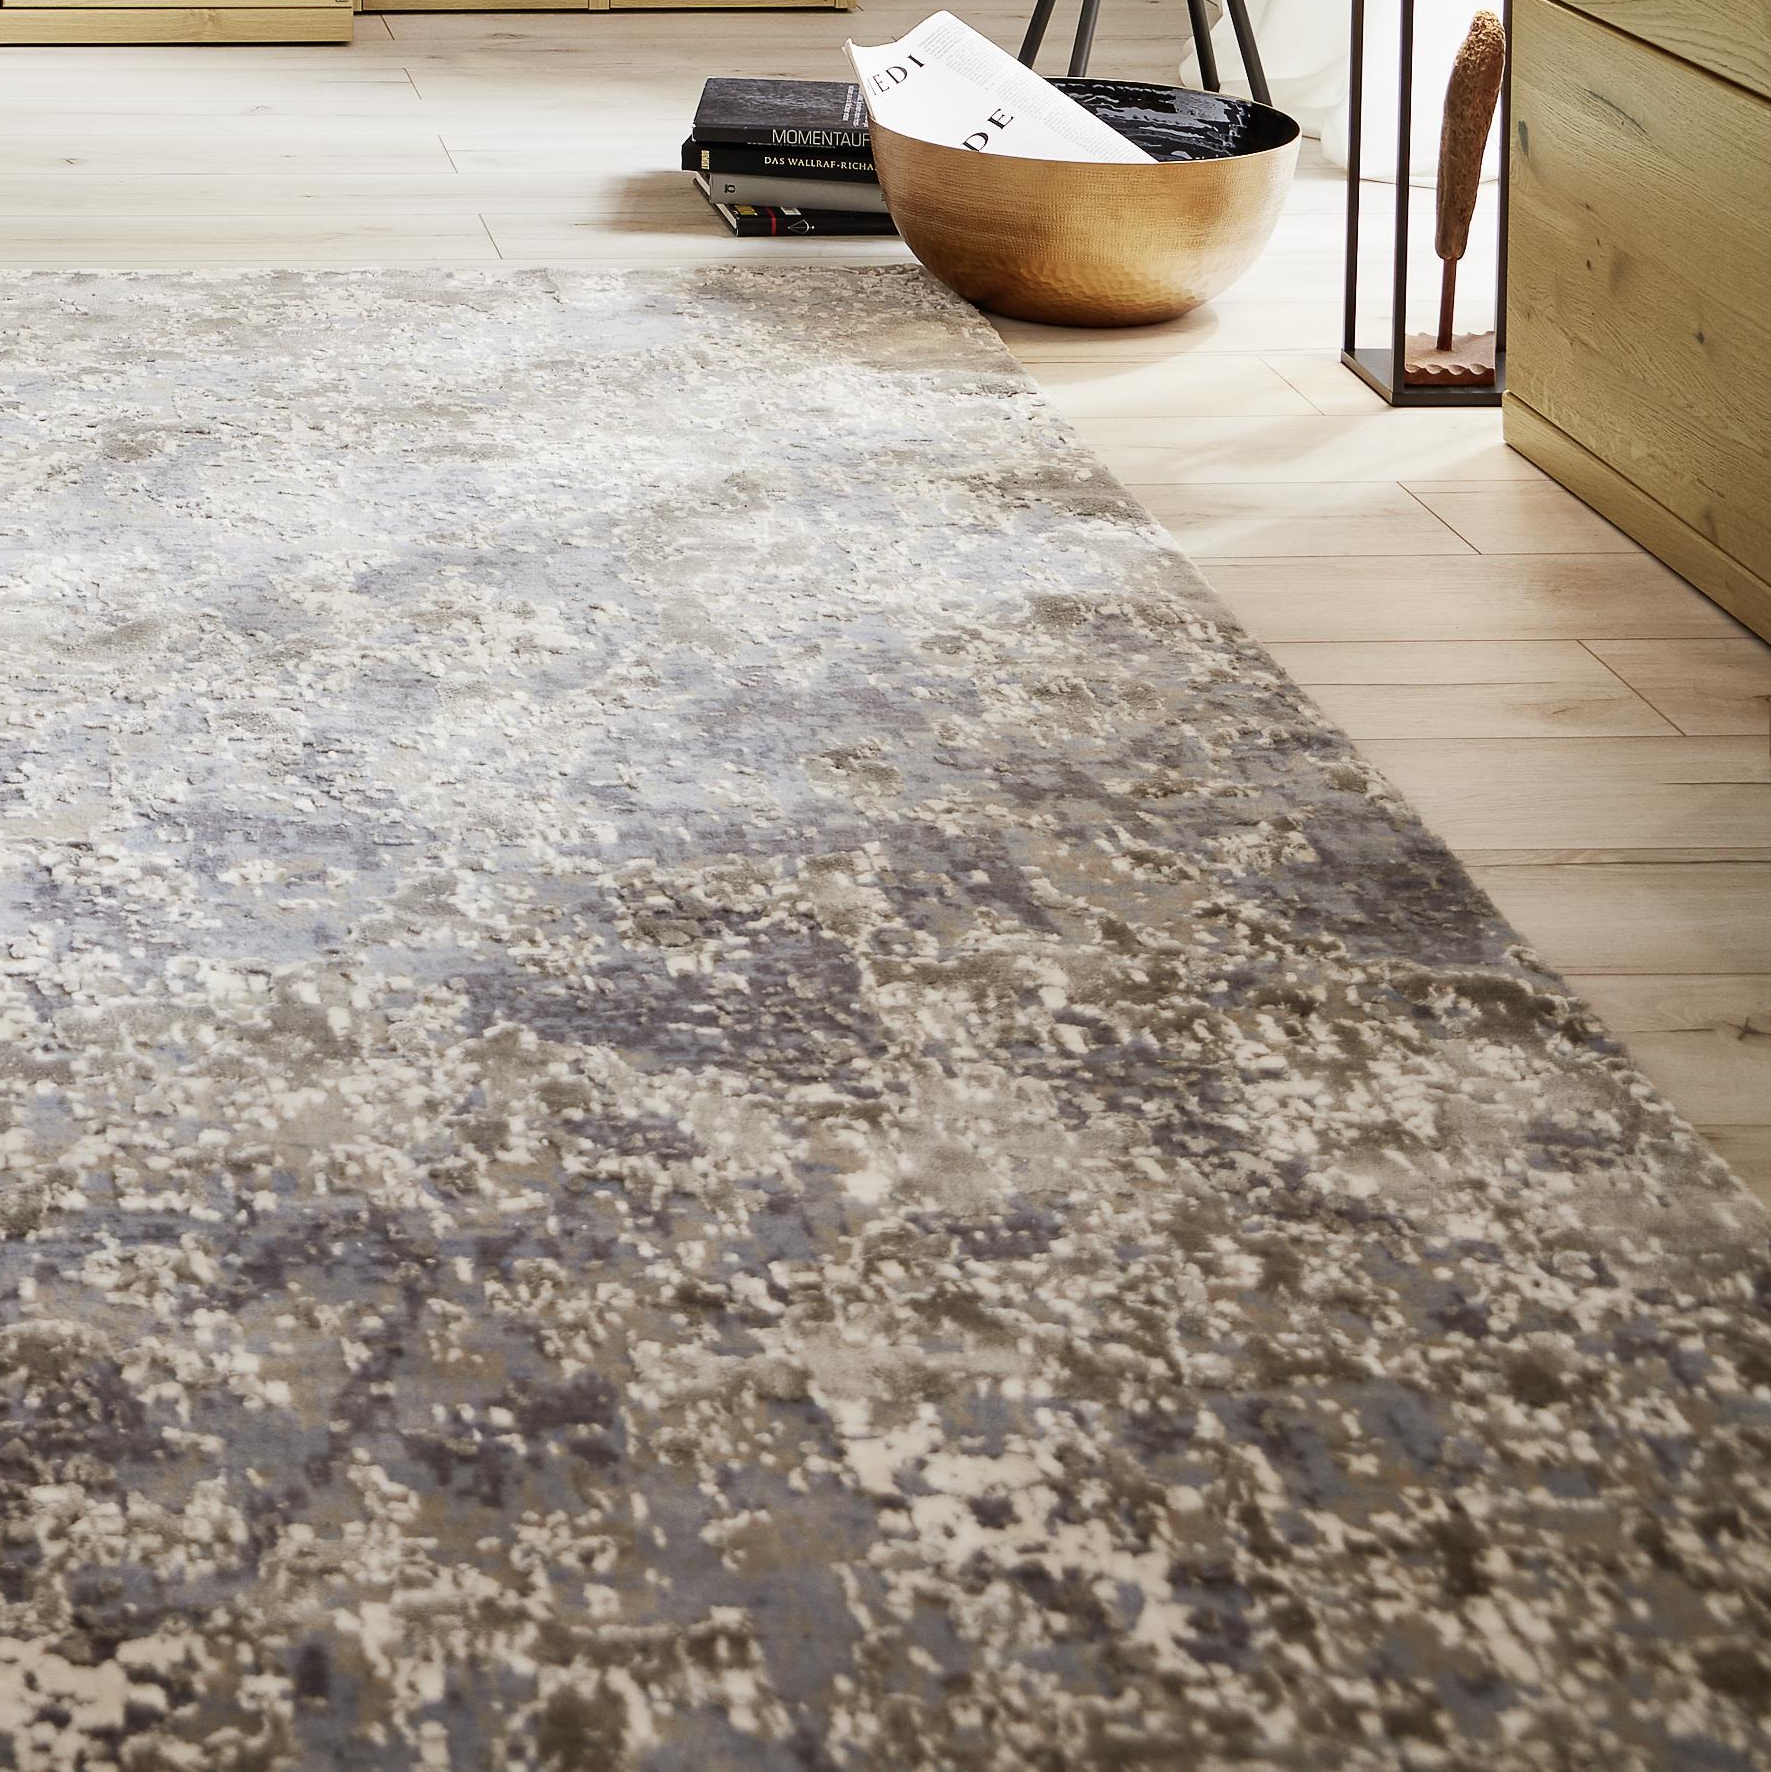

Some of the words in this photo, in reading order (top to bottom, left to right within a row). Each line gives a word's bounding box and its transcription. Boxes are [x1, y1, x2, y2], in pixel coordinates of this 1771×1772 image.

[866, 54, 926, 97] EDI
[772, 128, 870, 147] MOMENTAUF
[764, 156, 785, 165] DAS
[788, 158, 877, 171] WALLRAF-RICHA
